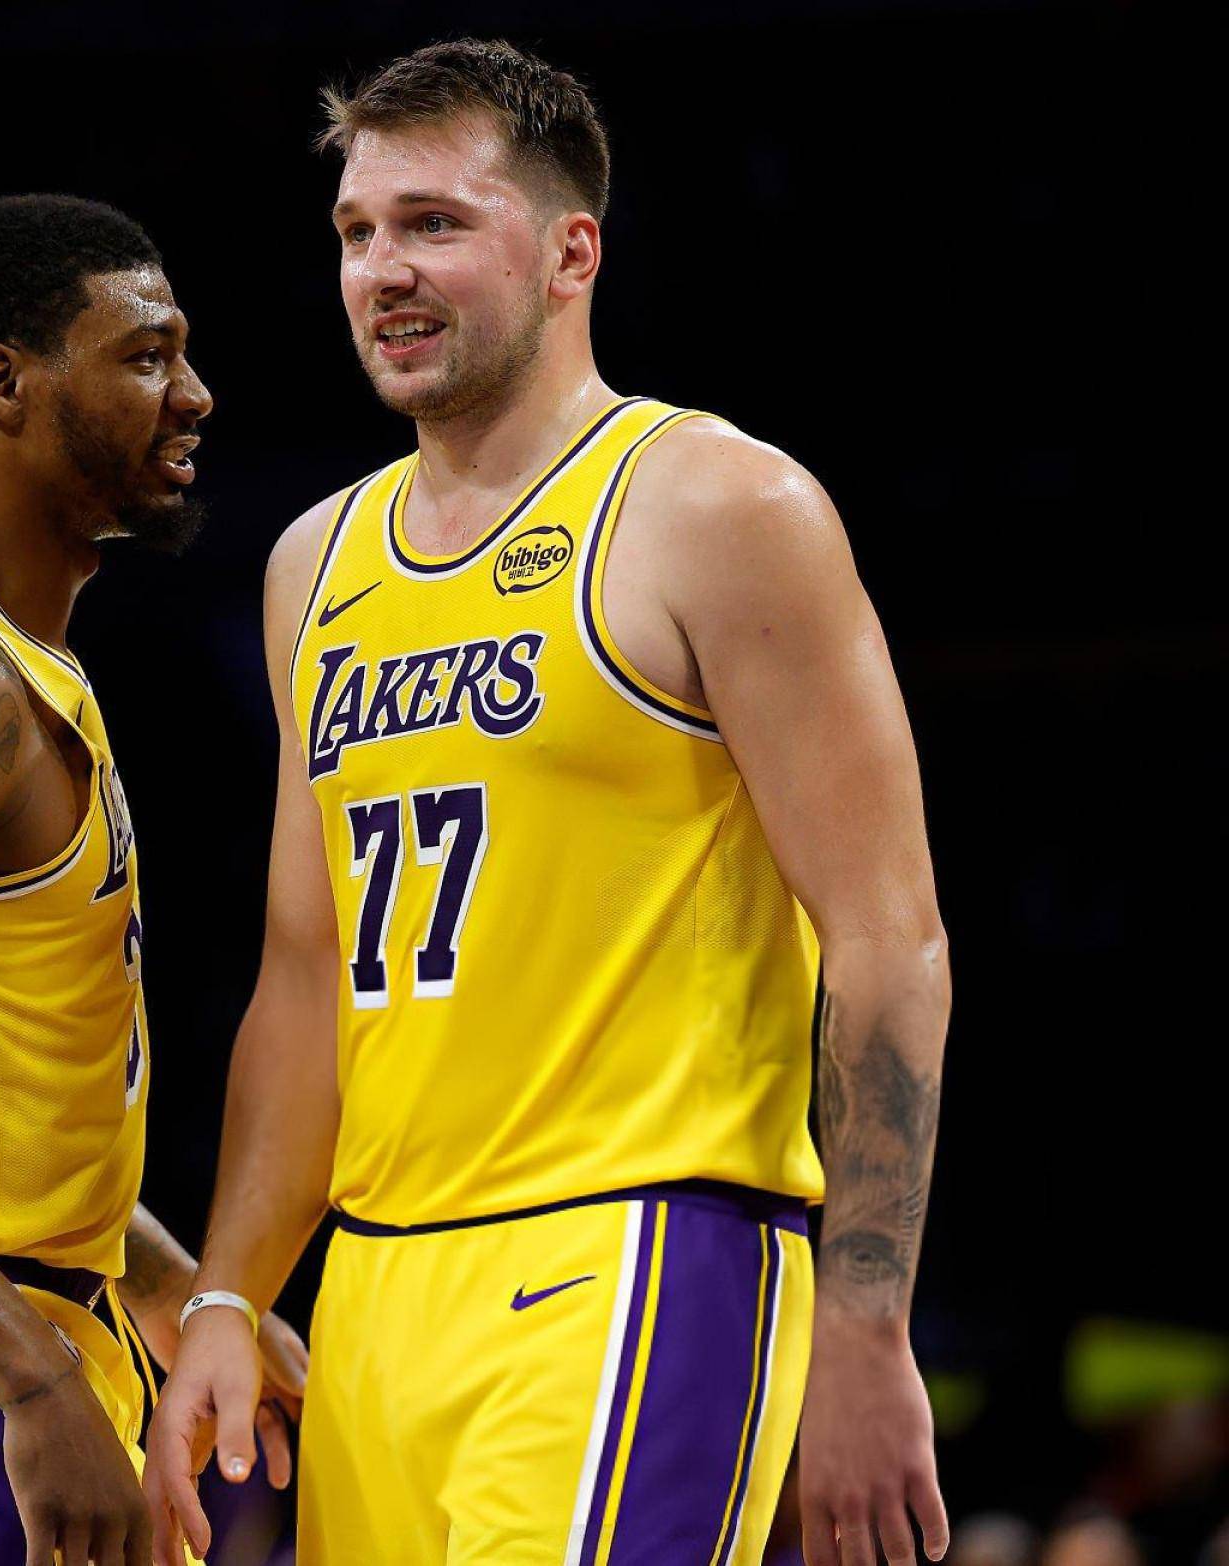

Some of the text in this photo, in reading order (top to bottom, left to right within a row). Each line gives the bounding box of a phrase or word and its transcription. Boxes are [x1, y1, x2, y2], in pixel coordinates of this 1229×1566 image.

[500, 542, 569, 572] bibigo
[308, 629, 550, 788] LAKERS
[343, 781, 491, 1011] 77
